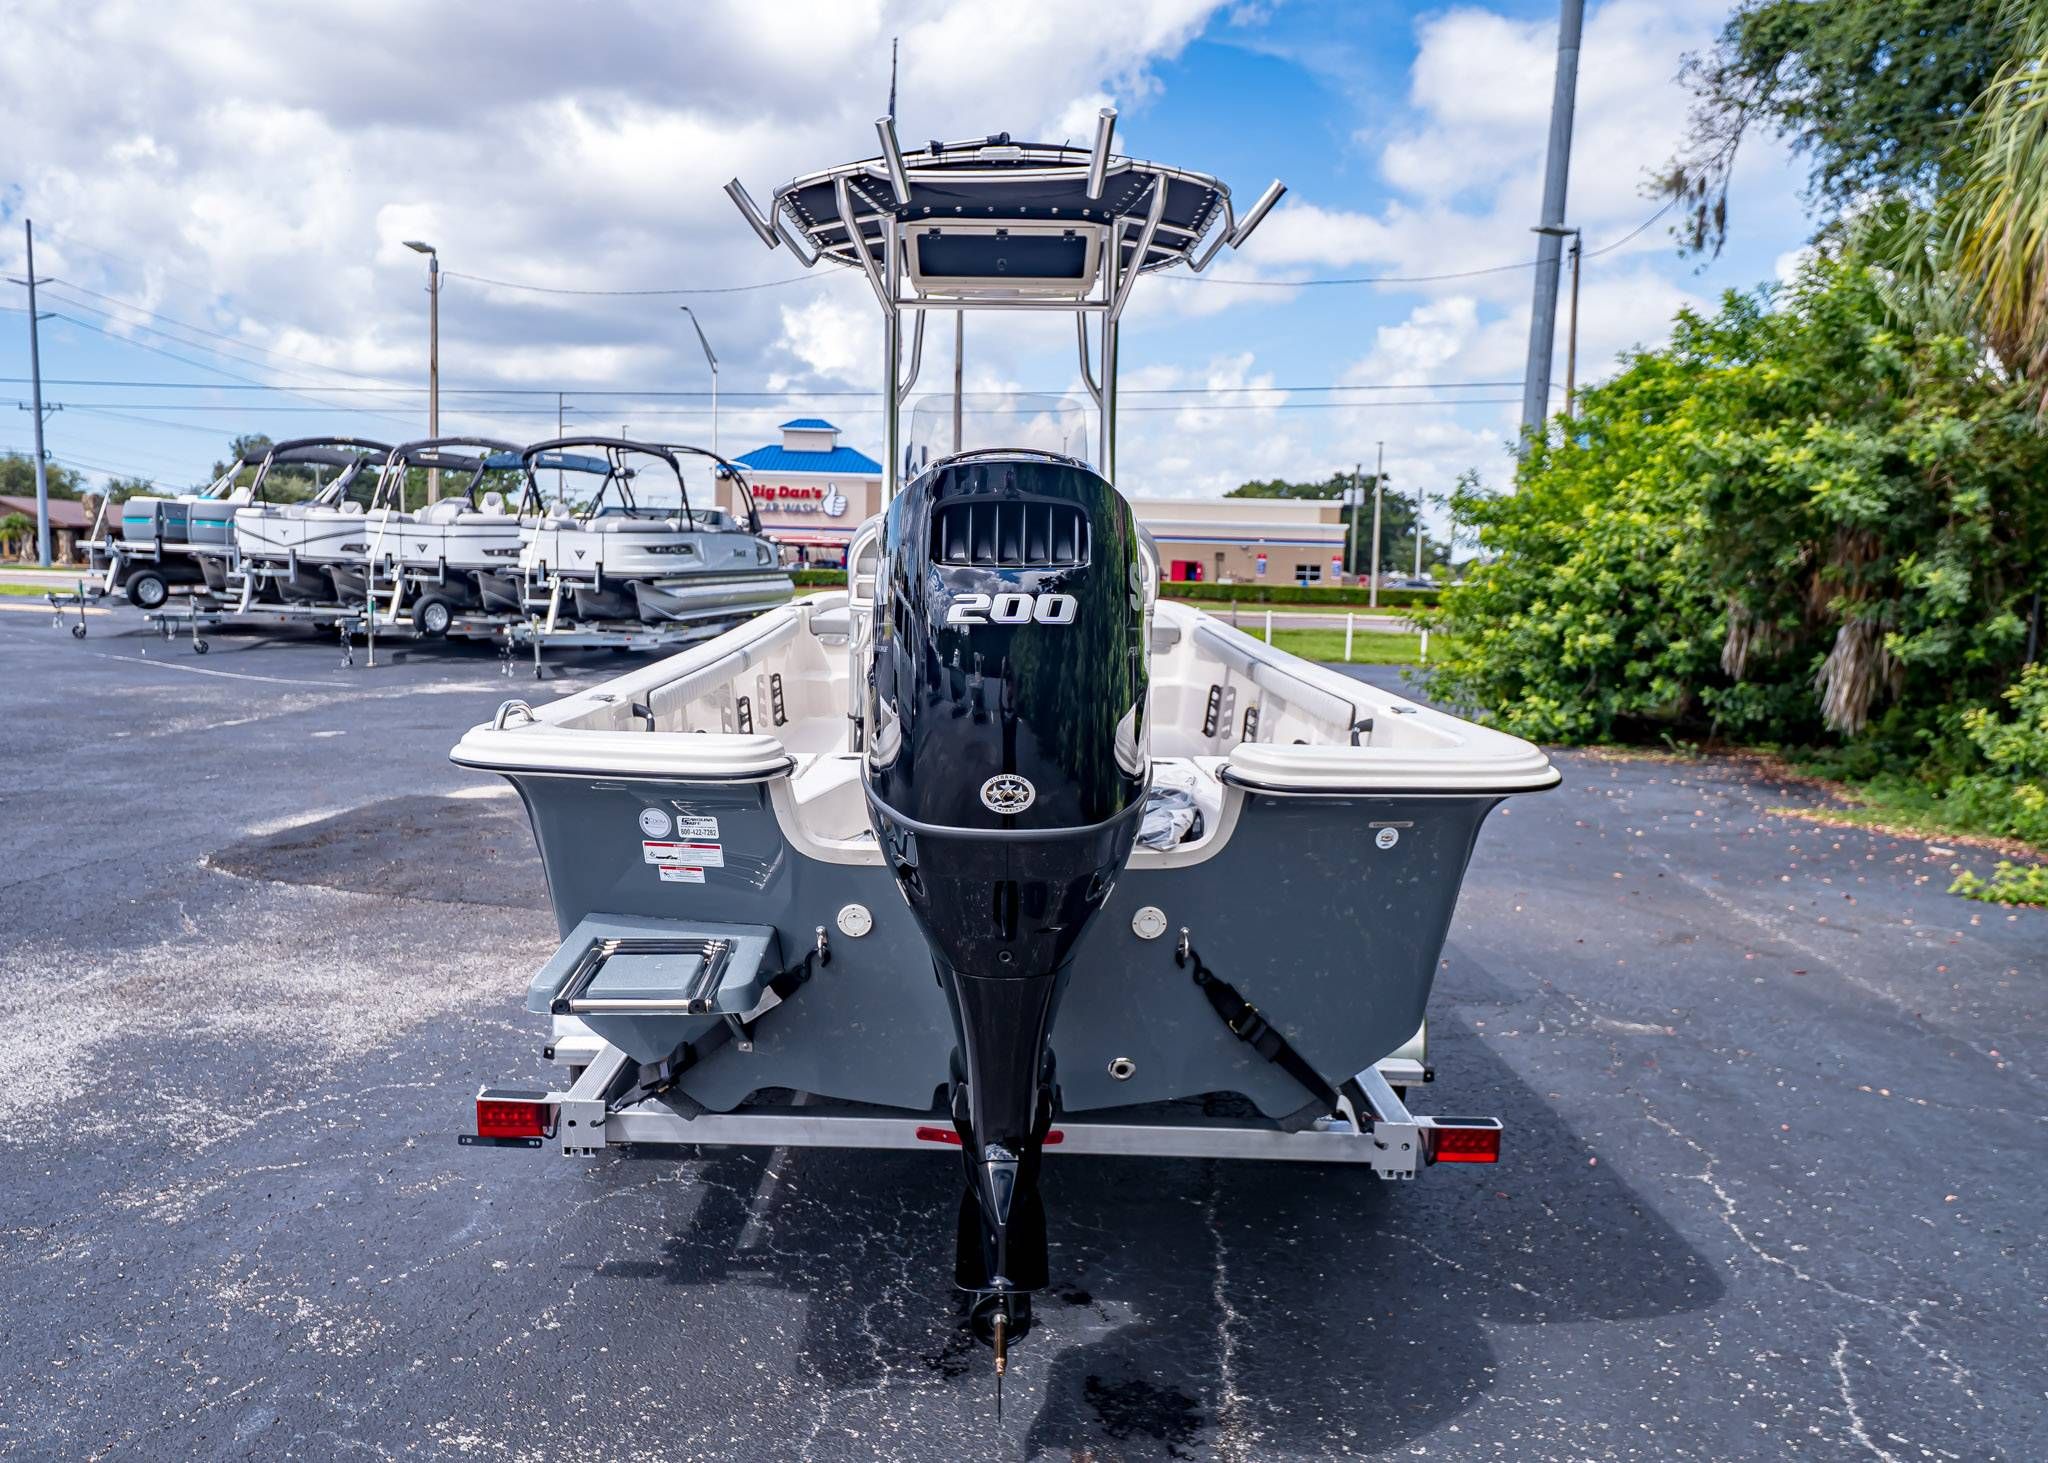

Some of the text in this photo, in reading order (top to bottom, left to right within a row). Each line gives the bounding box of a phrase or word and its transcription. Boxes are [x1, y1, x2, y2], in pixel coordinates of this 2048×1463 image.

[753, 485, 822, 501] Big Dan's
[947, 593, 1079, 625] 200
[989, 775, 1026, 784] ULTRA LOW
